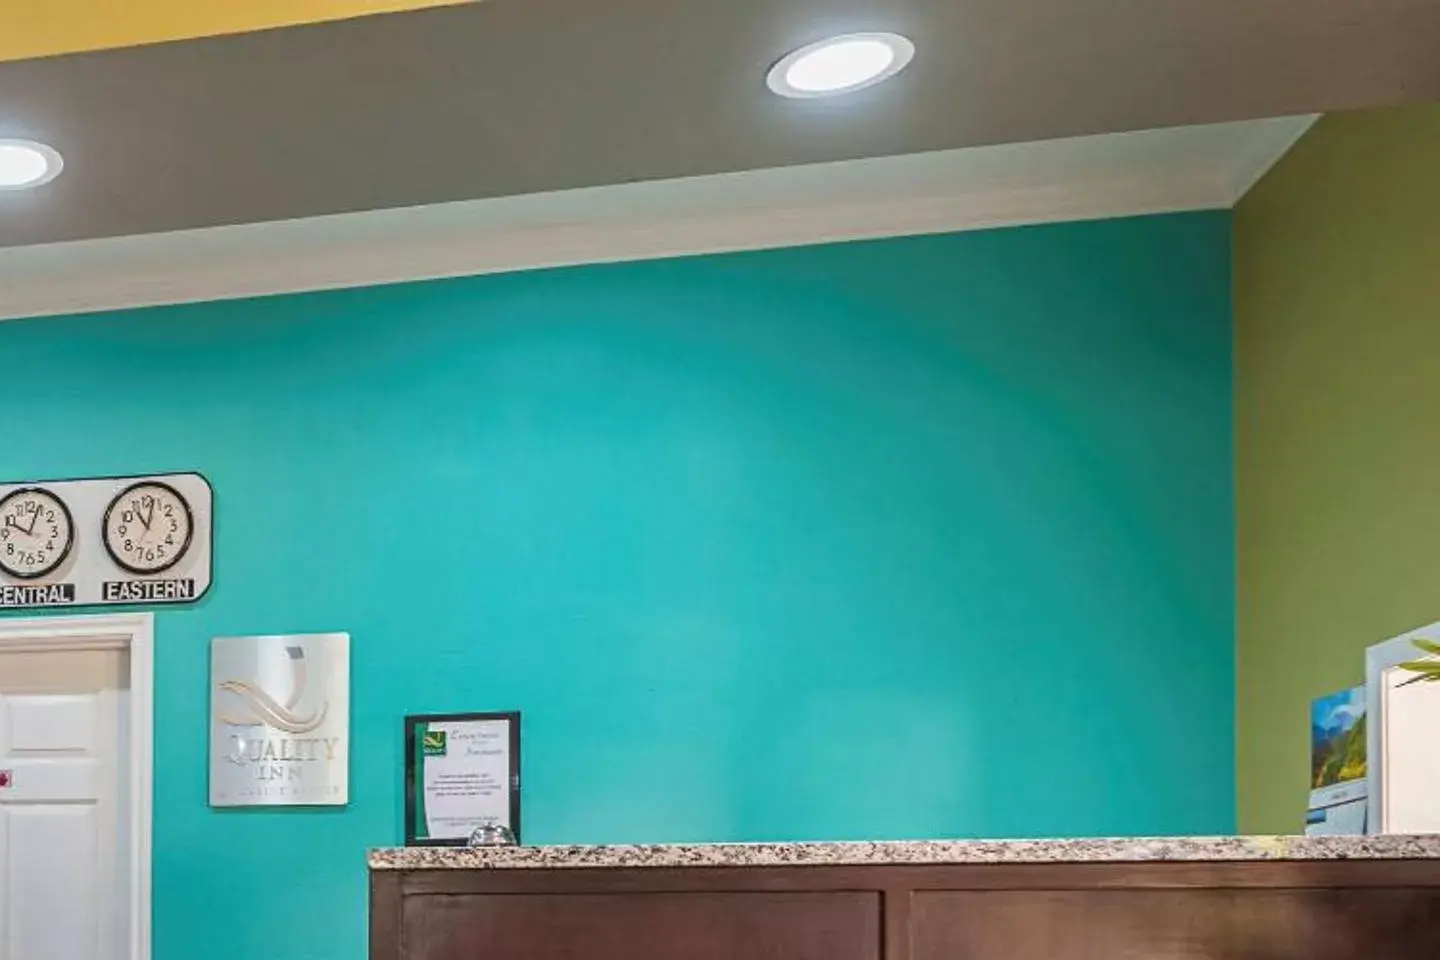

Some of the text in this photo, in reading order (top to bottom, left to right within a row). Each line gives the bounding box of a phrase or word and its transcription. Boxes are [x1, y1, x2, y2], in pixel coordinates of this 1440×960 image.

[15, 504, 24, 517] 11
[24, 500, 36, 514] 12
[157, 498, 162, 511] 1
[164, 504, 173, 517] 2
[45, 510, 55, 523] 2
[50, 526, 58, 538] 3
[118, 525, 127, 538] 9
[170, 519, 178, 532] 3
[0, 528, 10, 541] 9
[165, 534, 174, 546] 4
[6, 543, 14, 556] 8
[45, 540, 54, 552] 4
[124, 539, 133, 552] 8
[156, 545, 165, 558] 5
[17, 551, 26, 564] 7
[26, 552, 35, 565] 6
[37, 550, 45, 563] 5
[136, 546, 144, 559] 7
[145, 549, 155, 561] 6
[107, 580, 189, 600] EASTERN
[257, 766, 304, 780] INN
